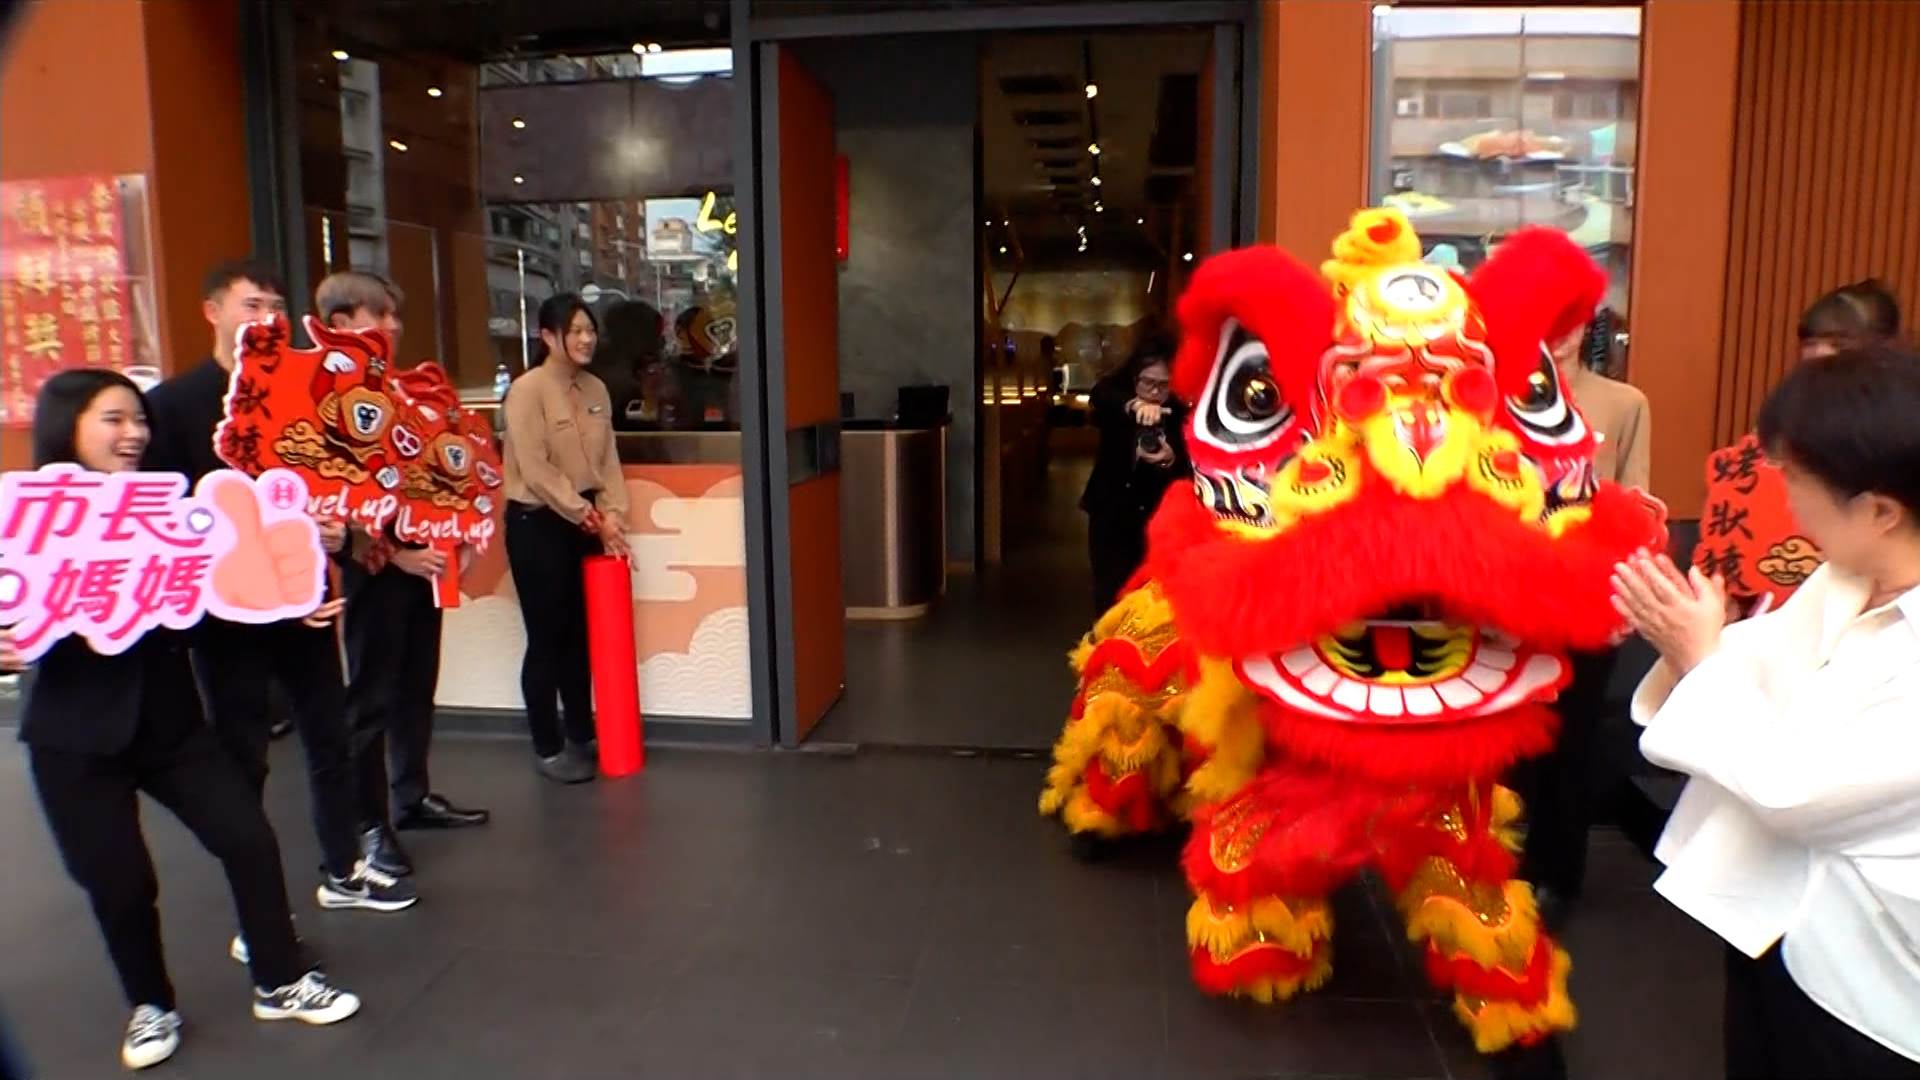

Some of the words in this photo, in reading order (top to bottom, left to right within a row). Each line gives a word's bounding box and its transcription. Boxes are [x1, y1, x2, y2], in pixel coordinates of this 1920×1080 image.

[3, 473, 205, 555] 市長
[307, 485, 398, 535] vel.up
[1701, 443, 1763, 592] 烤狀猿
[13, 553, 214, 650] 媽媽
